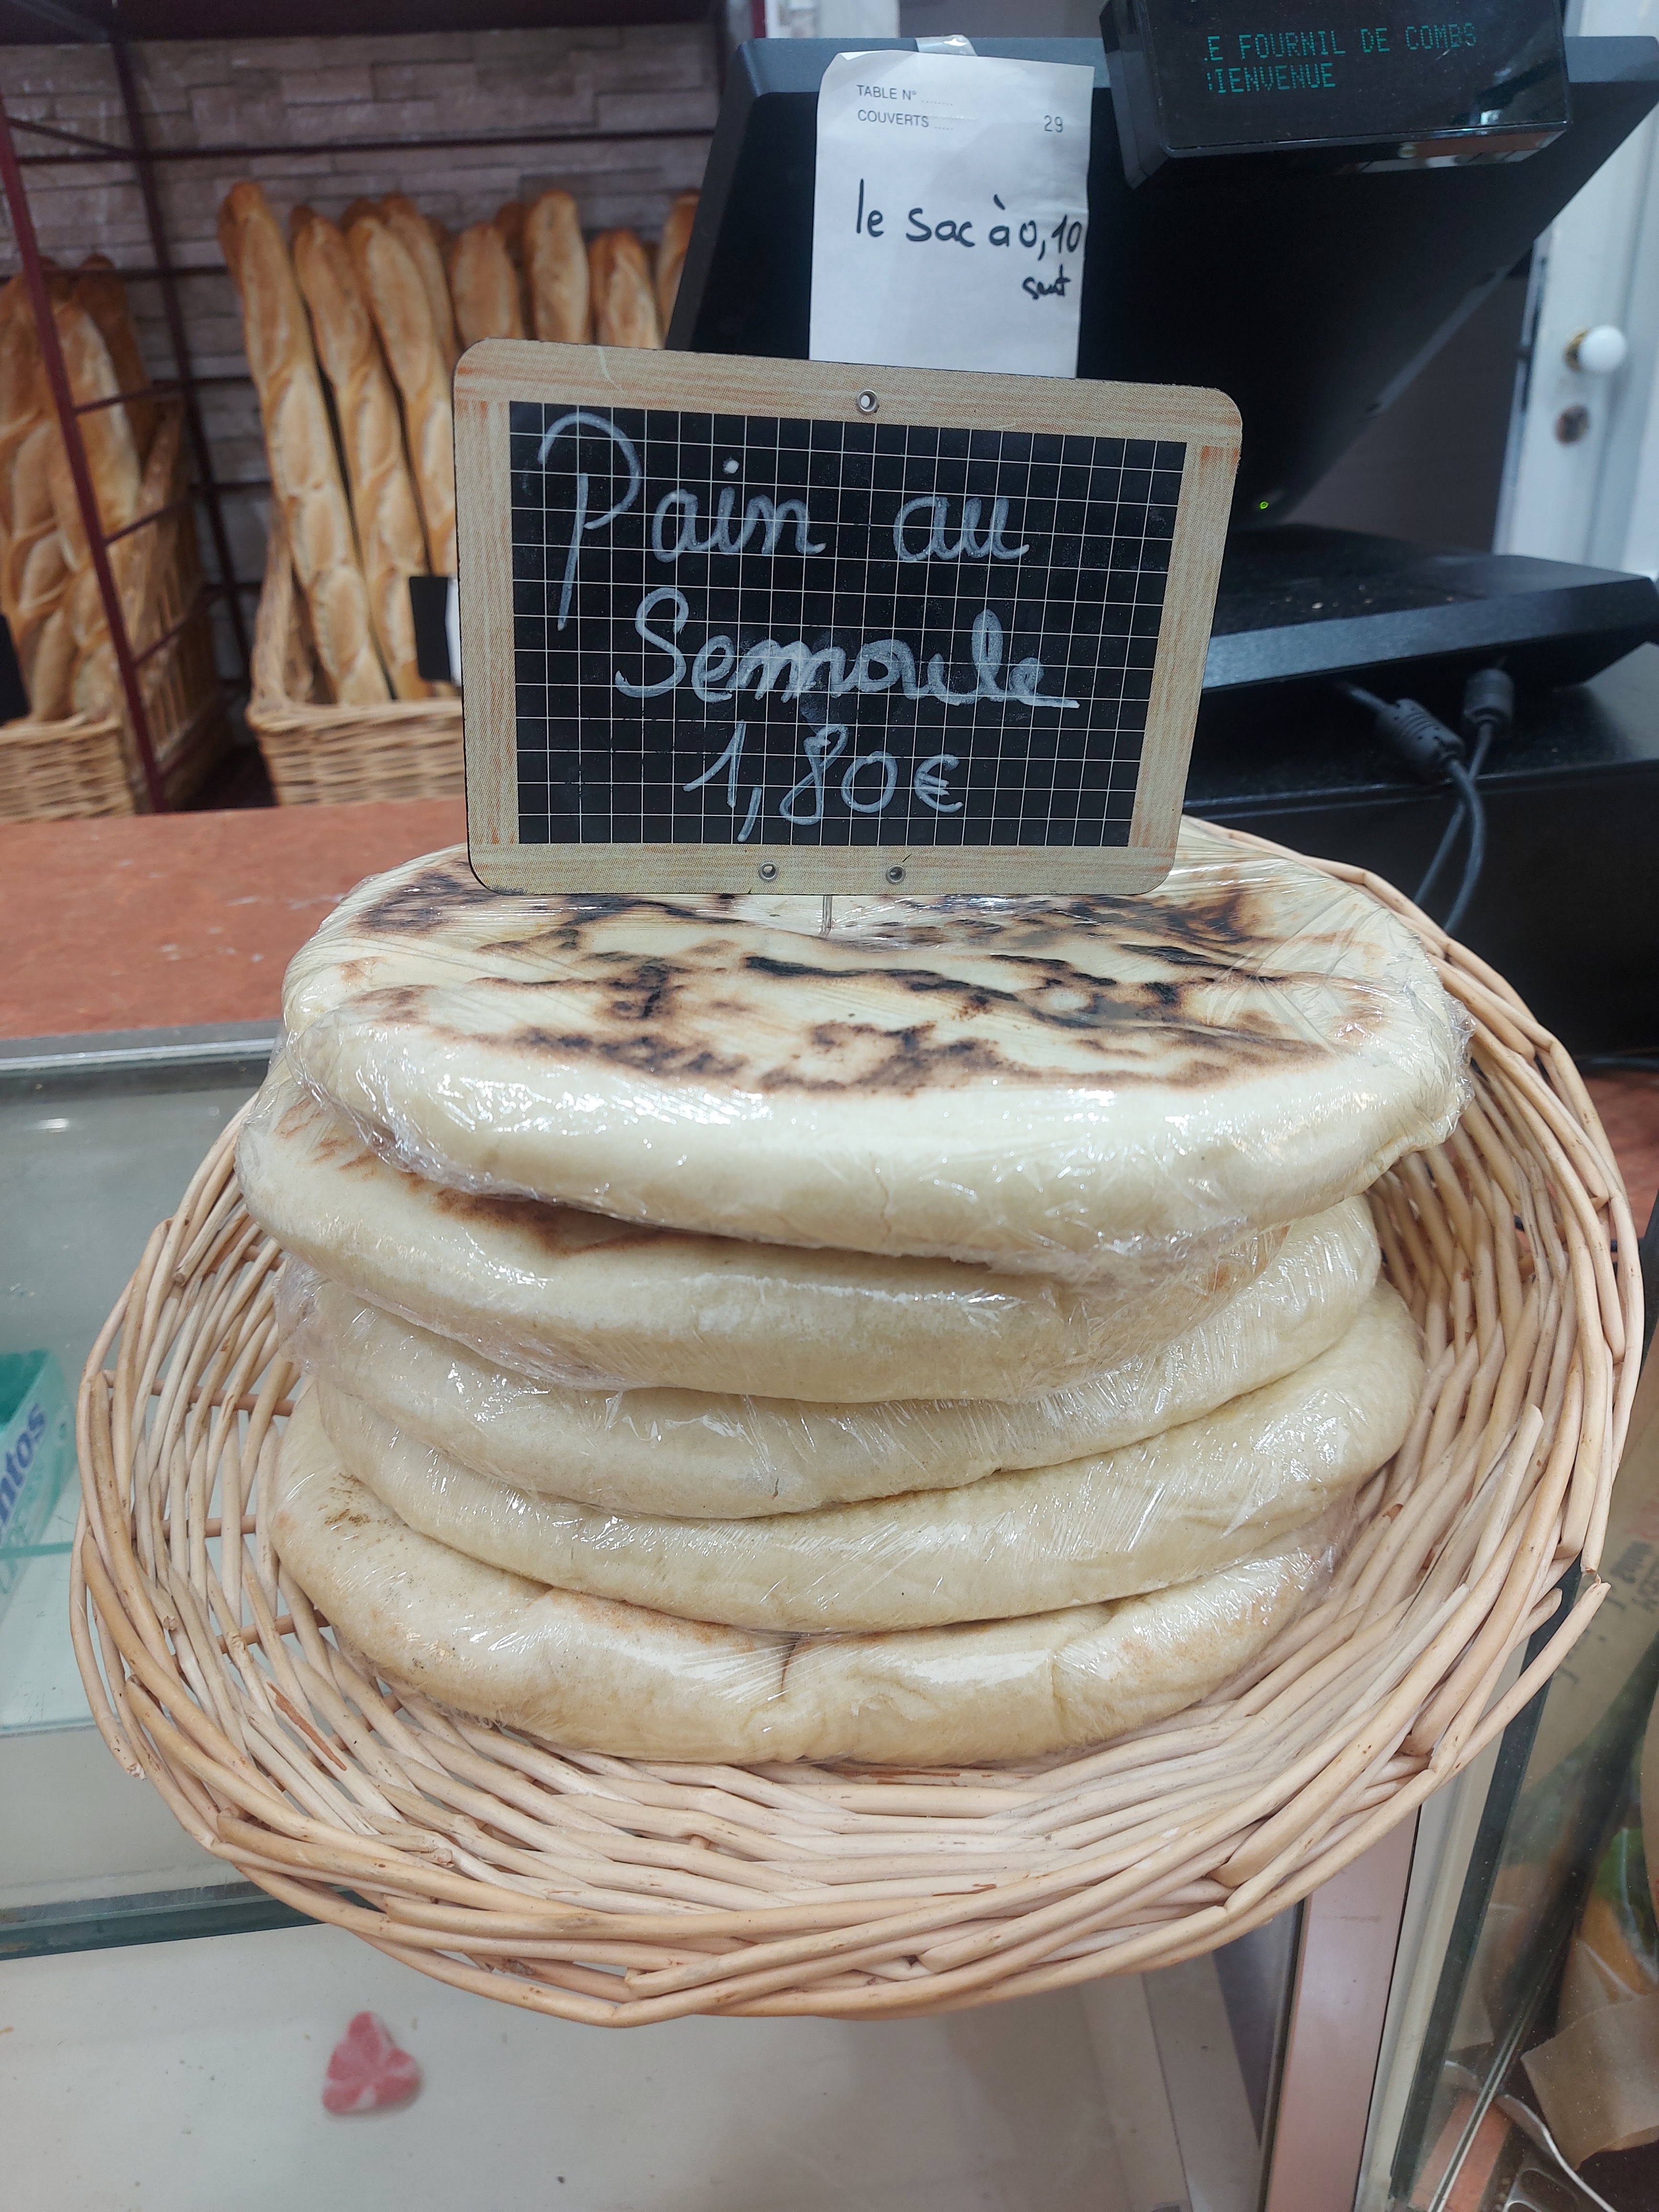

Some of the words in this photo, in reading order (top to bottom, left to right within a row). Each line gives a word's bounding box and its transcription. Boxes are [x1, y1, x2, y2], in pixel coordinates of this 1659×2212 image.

[1239, 30, 1346, 59] FOURNIL
[1360, 28, 1391, 53] DE
[1405, 22, 1478, 50] COMBS
[856, 84, 897, 100] TABLE
[857, 109, 929, 128] COUVERTS
[1043, 114, 1064, 133] 29
[856, 177, 884, 237] le
[989, 194, 1010, 247] à
[1019, 214, 1083, 261] 0,10
[538, 411, 827, 631] Pain
[894, 495, 1031, 562] au
[614, 586, 1081, 709] Semoule
[683, 719, 964, 842] 1,80€
